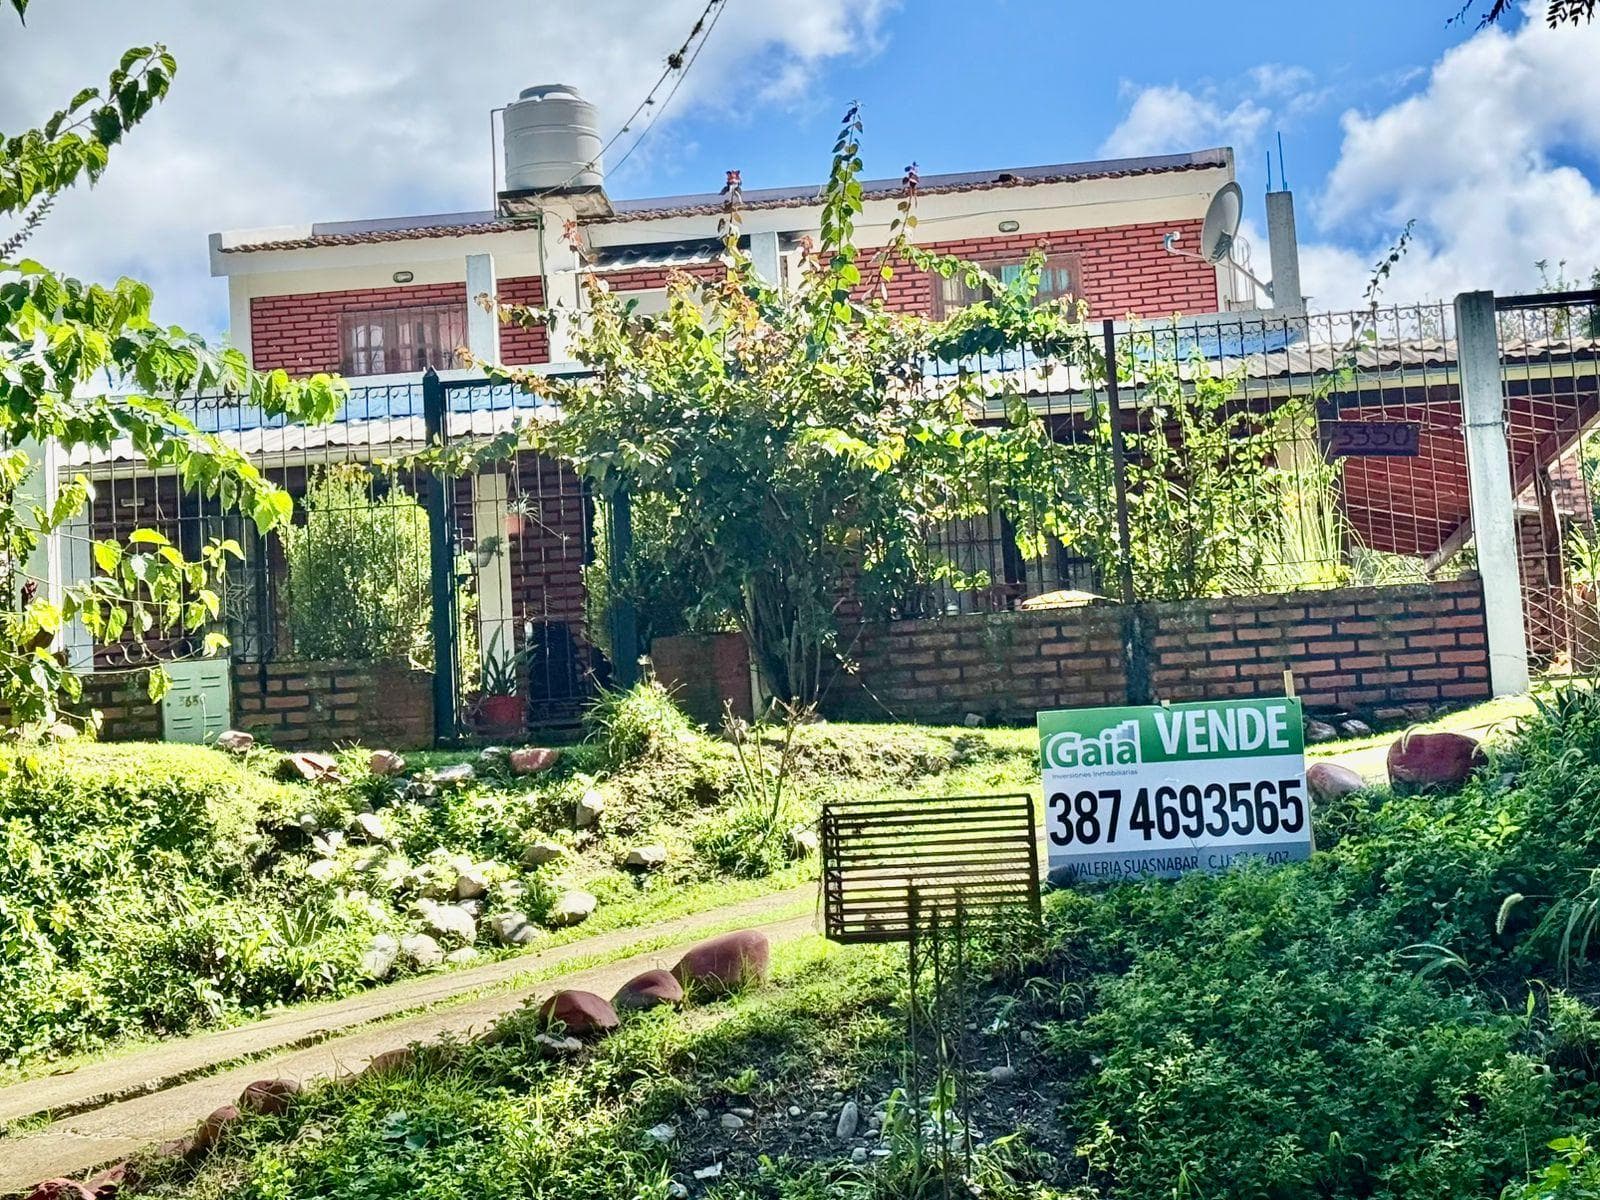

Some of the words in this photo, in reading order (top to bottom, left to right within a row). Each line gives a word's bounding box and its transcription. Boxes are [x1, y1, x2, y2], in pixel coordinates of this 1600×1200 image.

[1154, 705, 1290, 755] VENDE
[1049, 733, 1138, 768] Gaia
[1071, 861, 1122, 877] VALERIA
[1123, 856, 1199, 874] SUASNABAR
